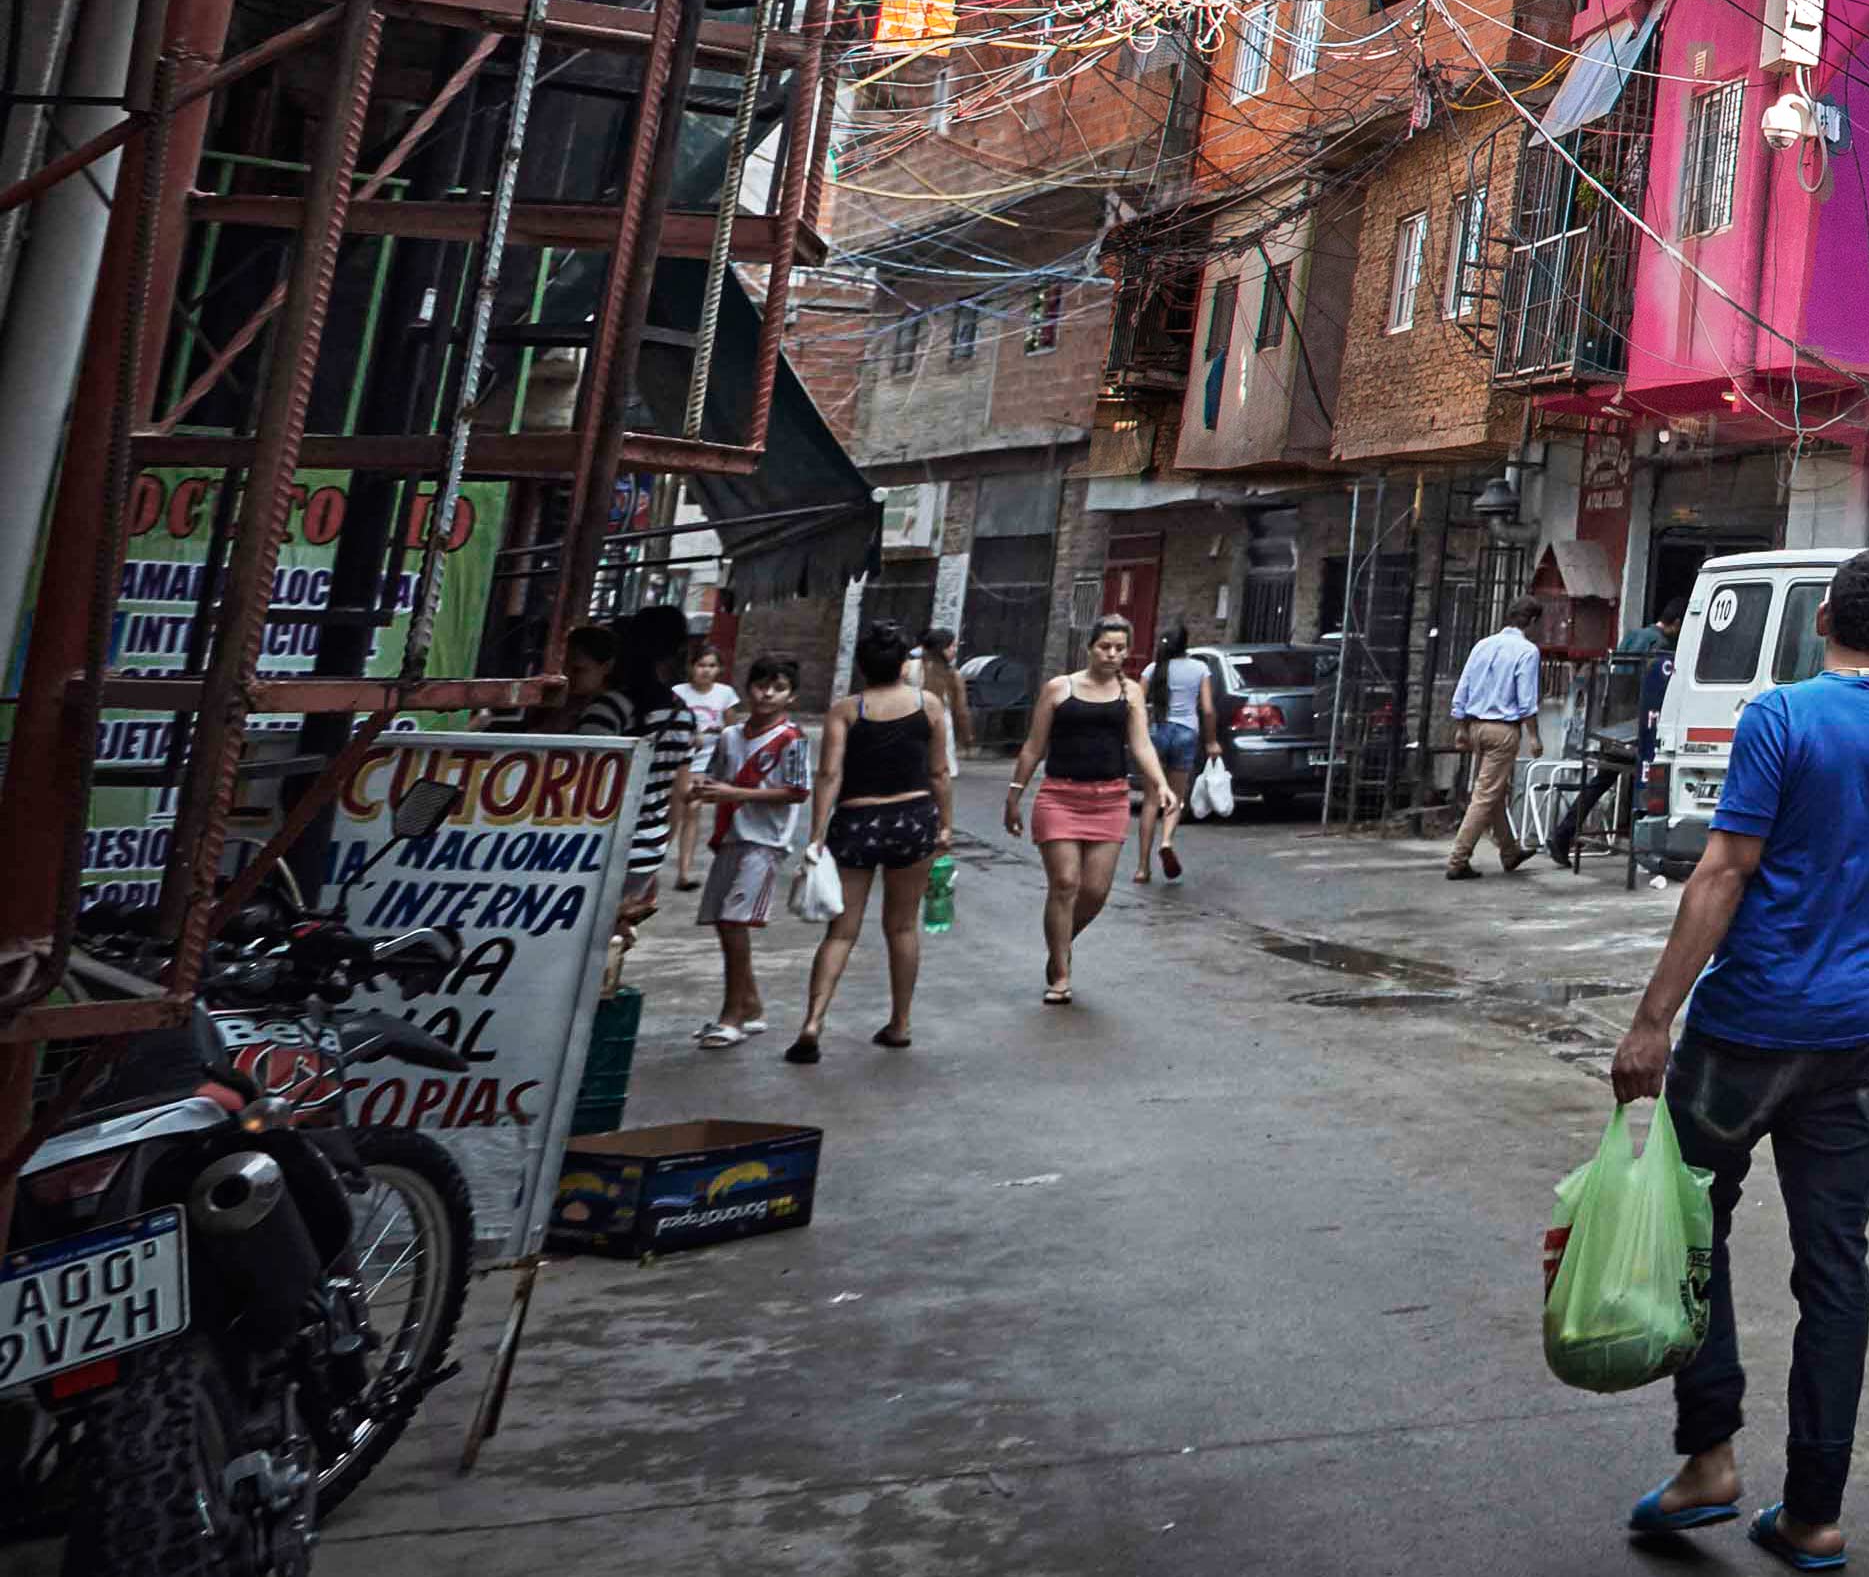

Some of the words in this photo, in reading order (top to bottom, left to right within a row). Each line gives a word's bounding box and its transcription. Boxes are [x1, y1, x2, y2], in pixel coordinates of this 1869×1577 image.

[1714, 598, 1732, 622] 110
[341, 748, 630, 826] CUTORIO
[364, 880, 587, 937] INTERNA
[14, 1249, 134, 1327] A00
